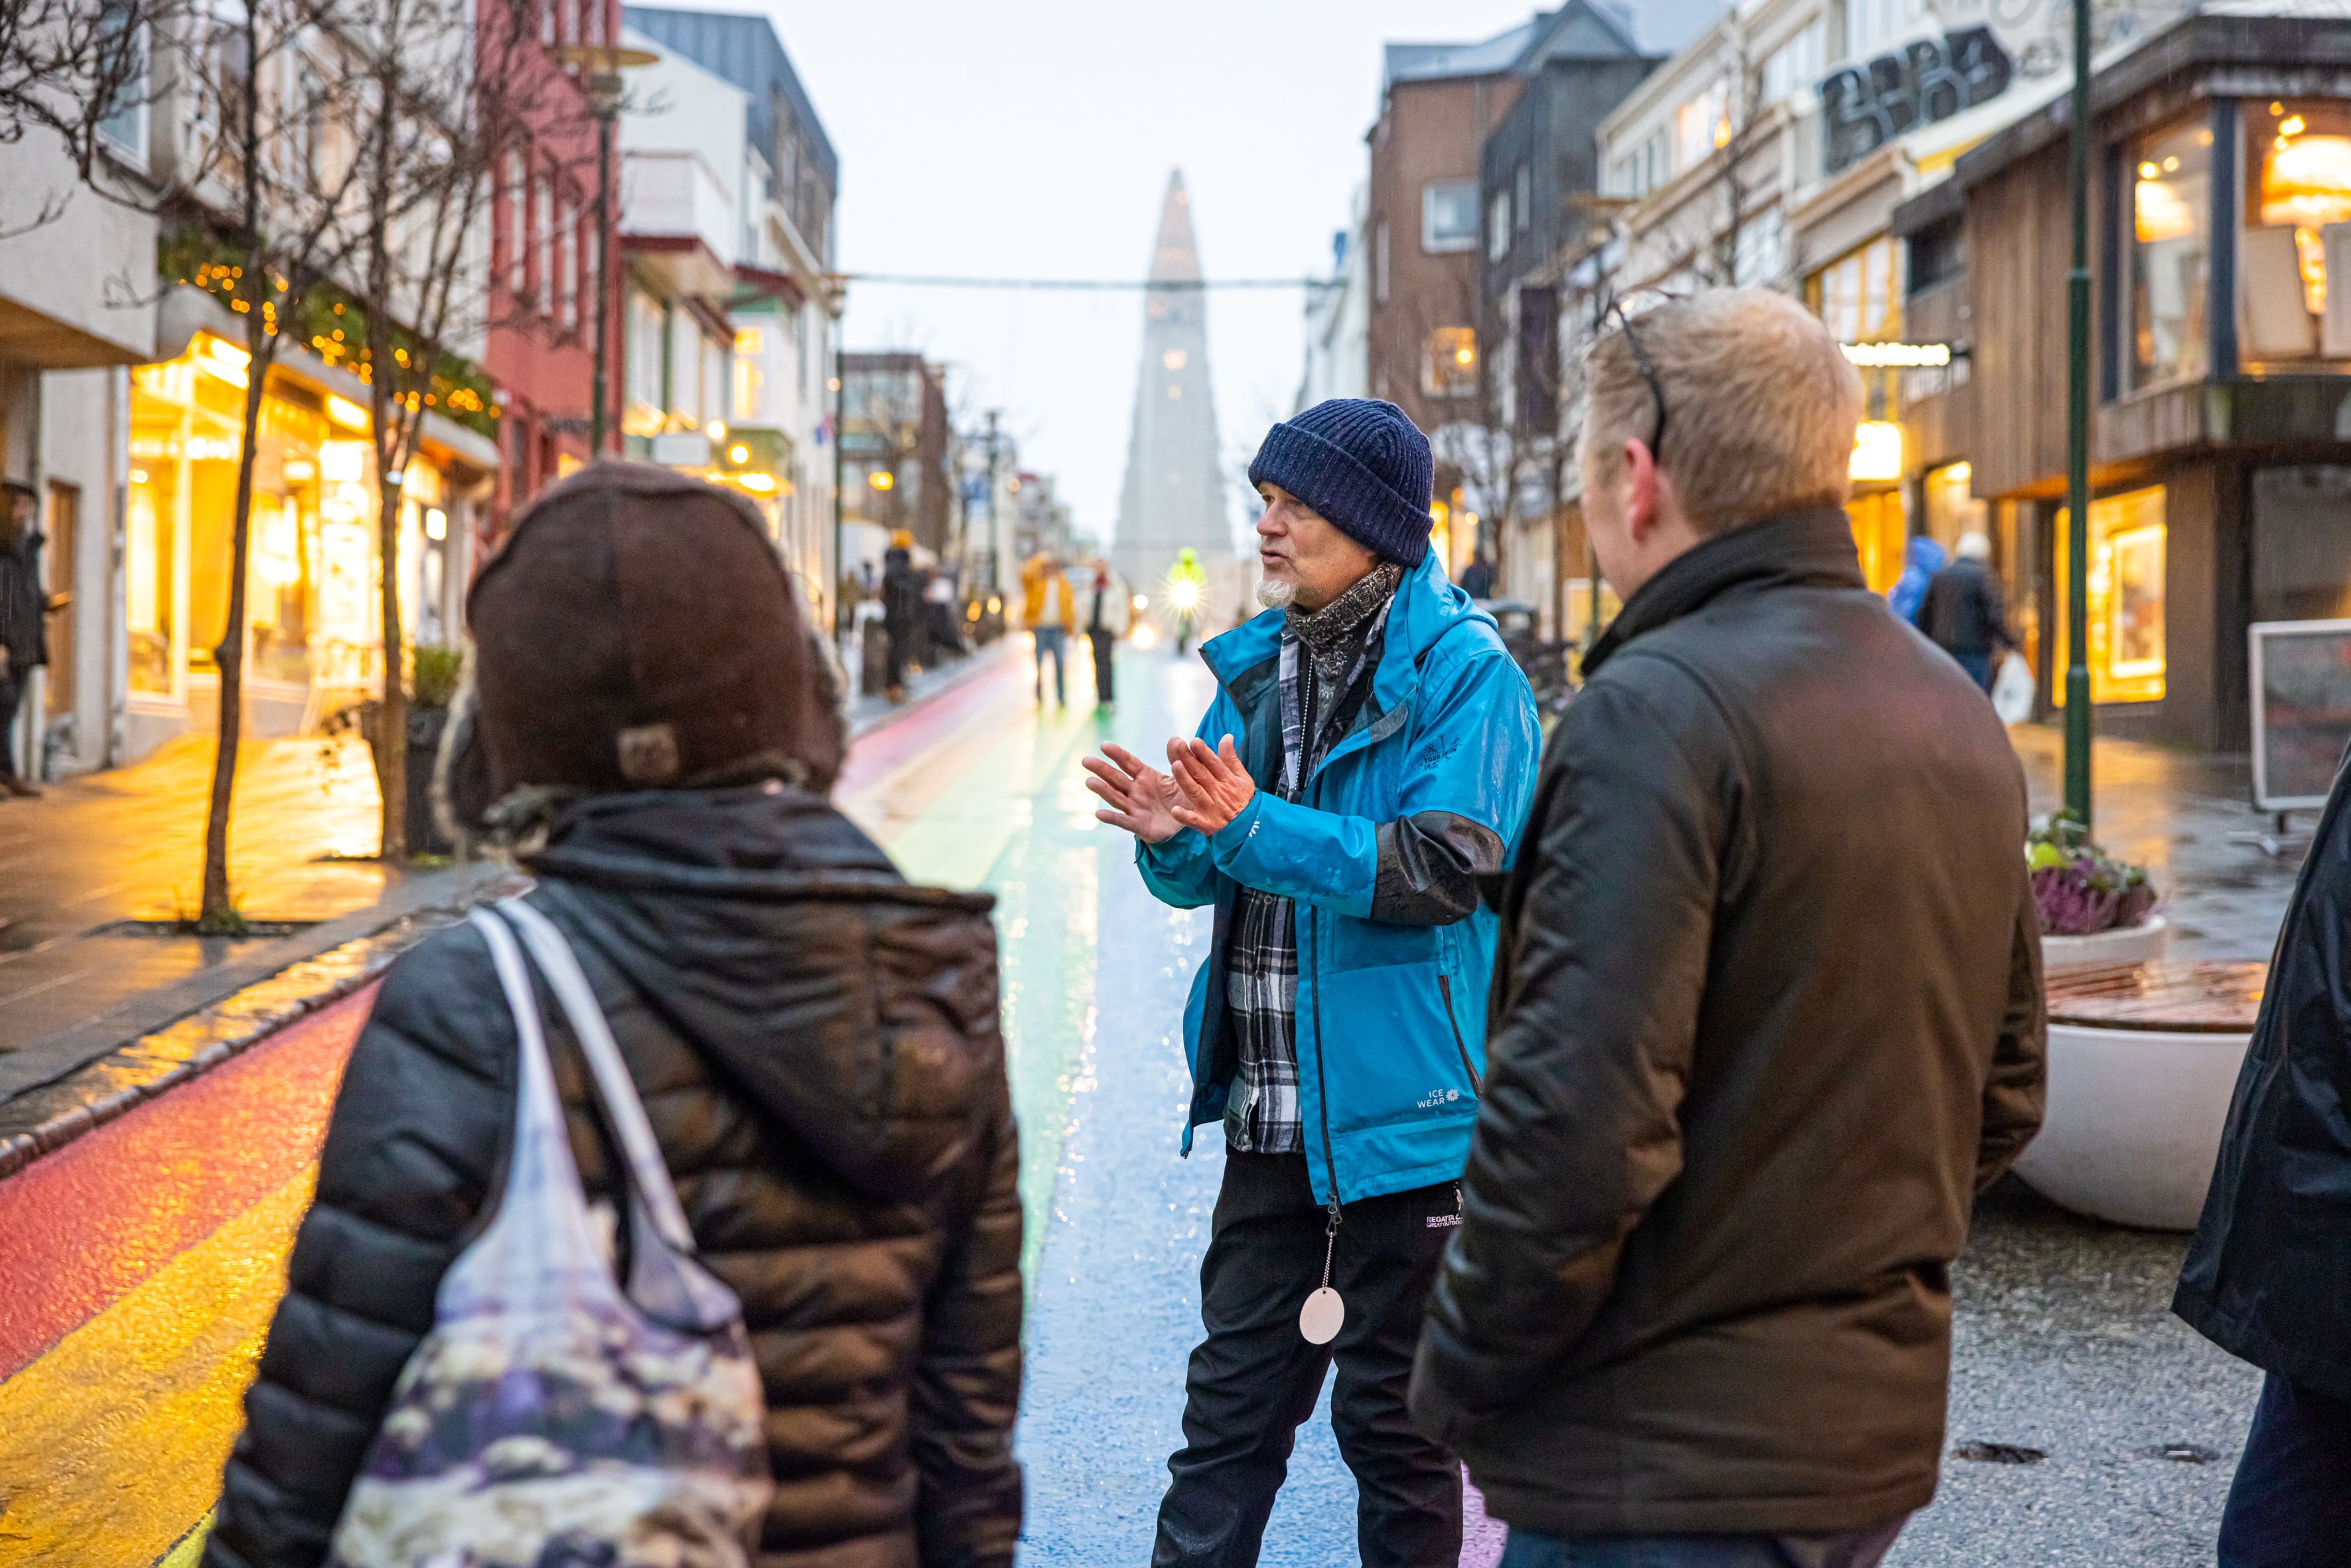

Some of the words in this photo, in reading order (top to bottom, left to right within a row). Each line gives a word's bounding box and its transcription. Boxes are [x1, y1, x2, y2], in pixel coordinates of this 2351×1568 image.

[1429, 1089, 1444, 1098] ICE
[1417, 1098, 1445, 1108] WEAR
[1427, 1214, 1455, 1223] REGATTA
